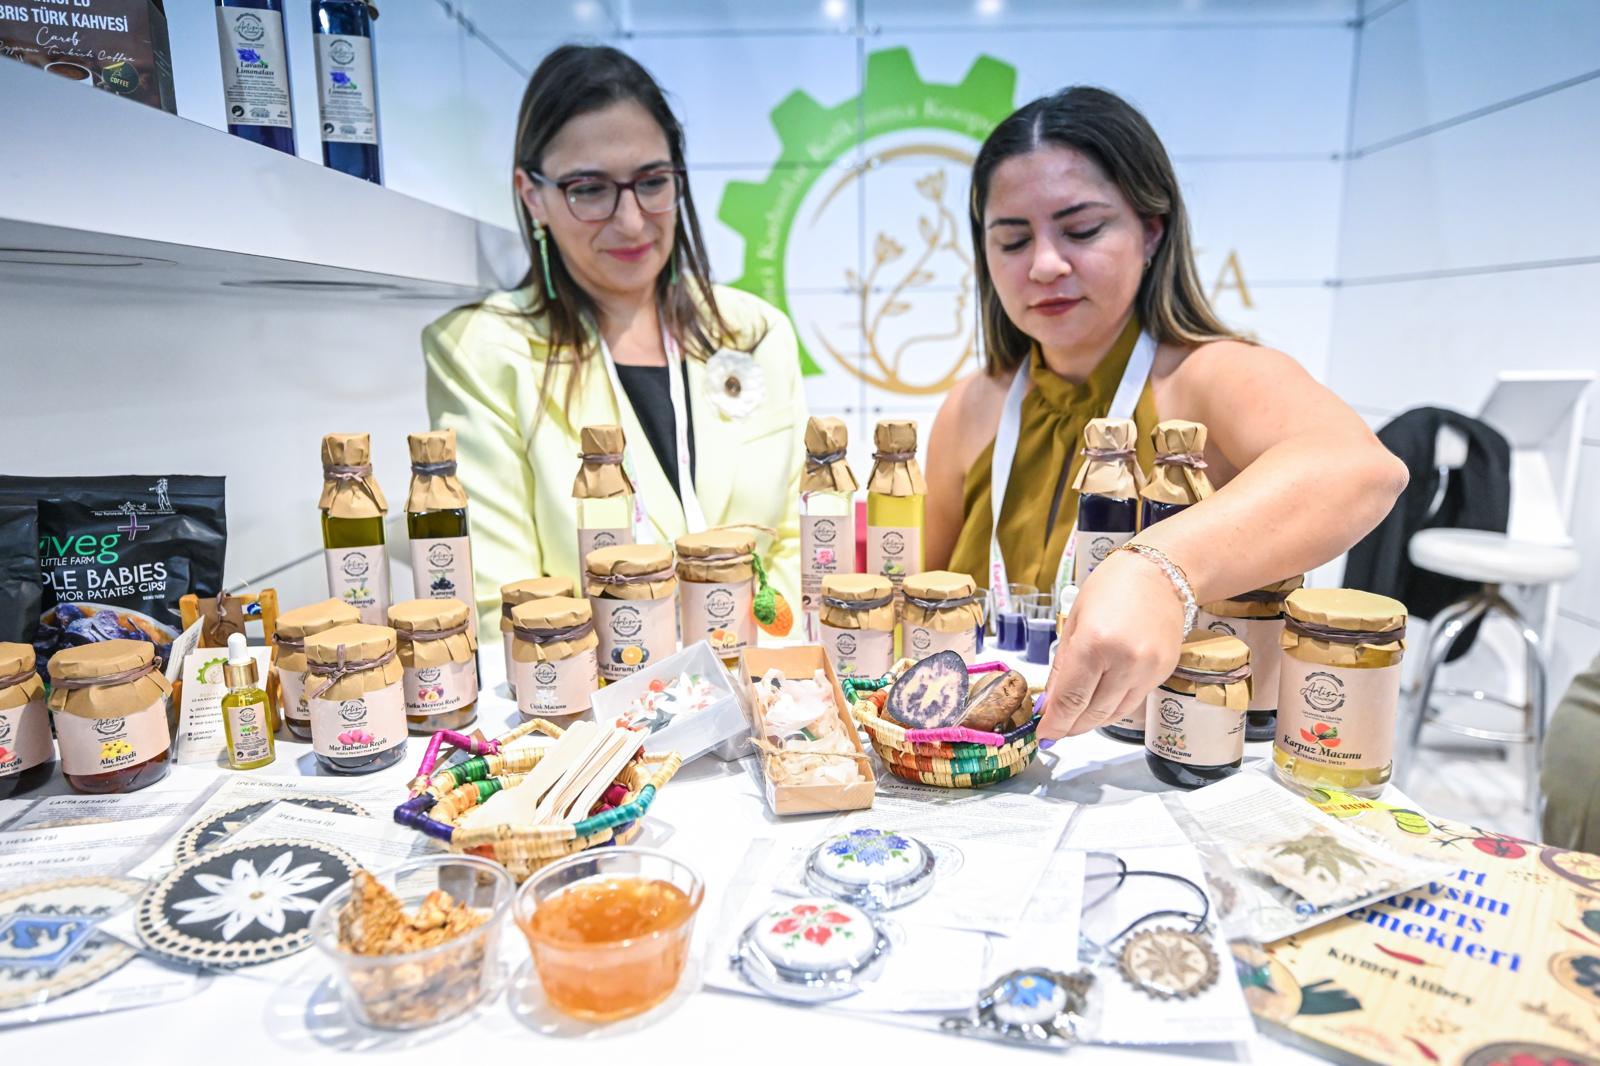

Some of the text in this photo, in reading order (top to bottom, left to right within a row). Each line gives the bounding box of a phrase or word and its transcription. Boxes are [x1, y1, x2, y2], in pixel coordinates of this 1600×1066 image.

[31, 7, 69, 27] TÜRK
[72, 14, 129, 33] KAHVESİ
[36, 26, 81, 46] Carob
[97, 50, 136, 62] Coffee
[110, 77, 130, 88] COFFEE
[40, 556, 95, 567] LITTLE FARM
[87, 562, 168, 589] BABIES
[57, 591, 84, 601] MOR
[87, 587, 135, 600] PATATES
[1300, 681, 1346, 698] Artisan
[369, 737, 388, 748] Reçeli
[1283, 734, 1362, 760] Karpuz Macunu
[99, 757, 115, 766] Alıç
[115, 751, 137, 763] Reçeli
[1166, 746, 1193, 758] Macunu
[0, 757, 23, 769] Reçeli
[1457, 867, 1488, 887] rt
[1426, 880, 1511, 918] vsim
[1345, 905, 1522, 973] emekleri
